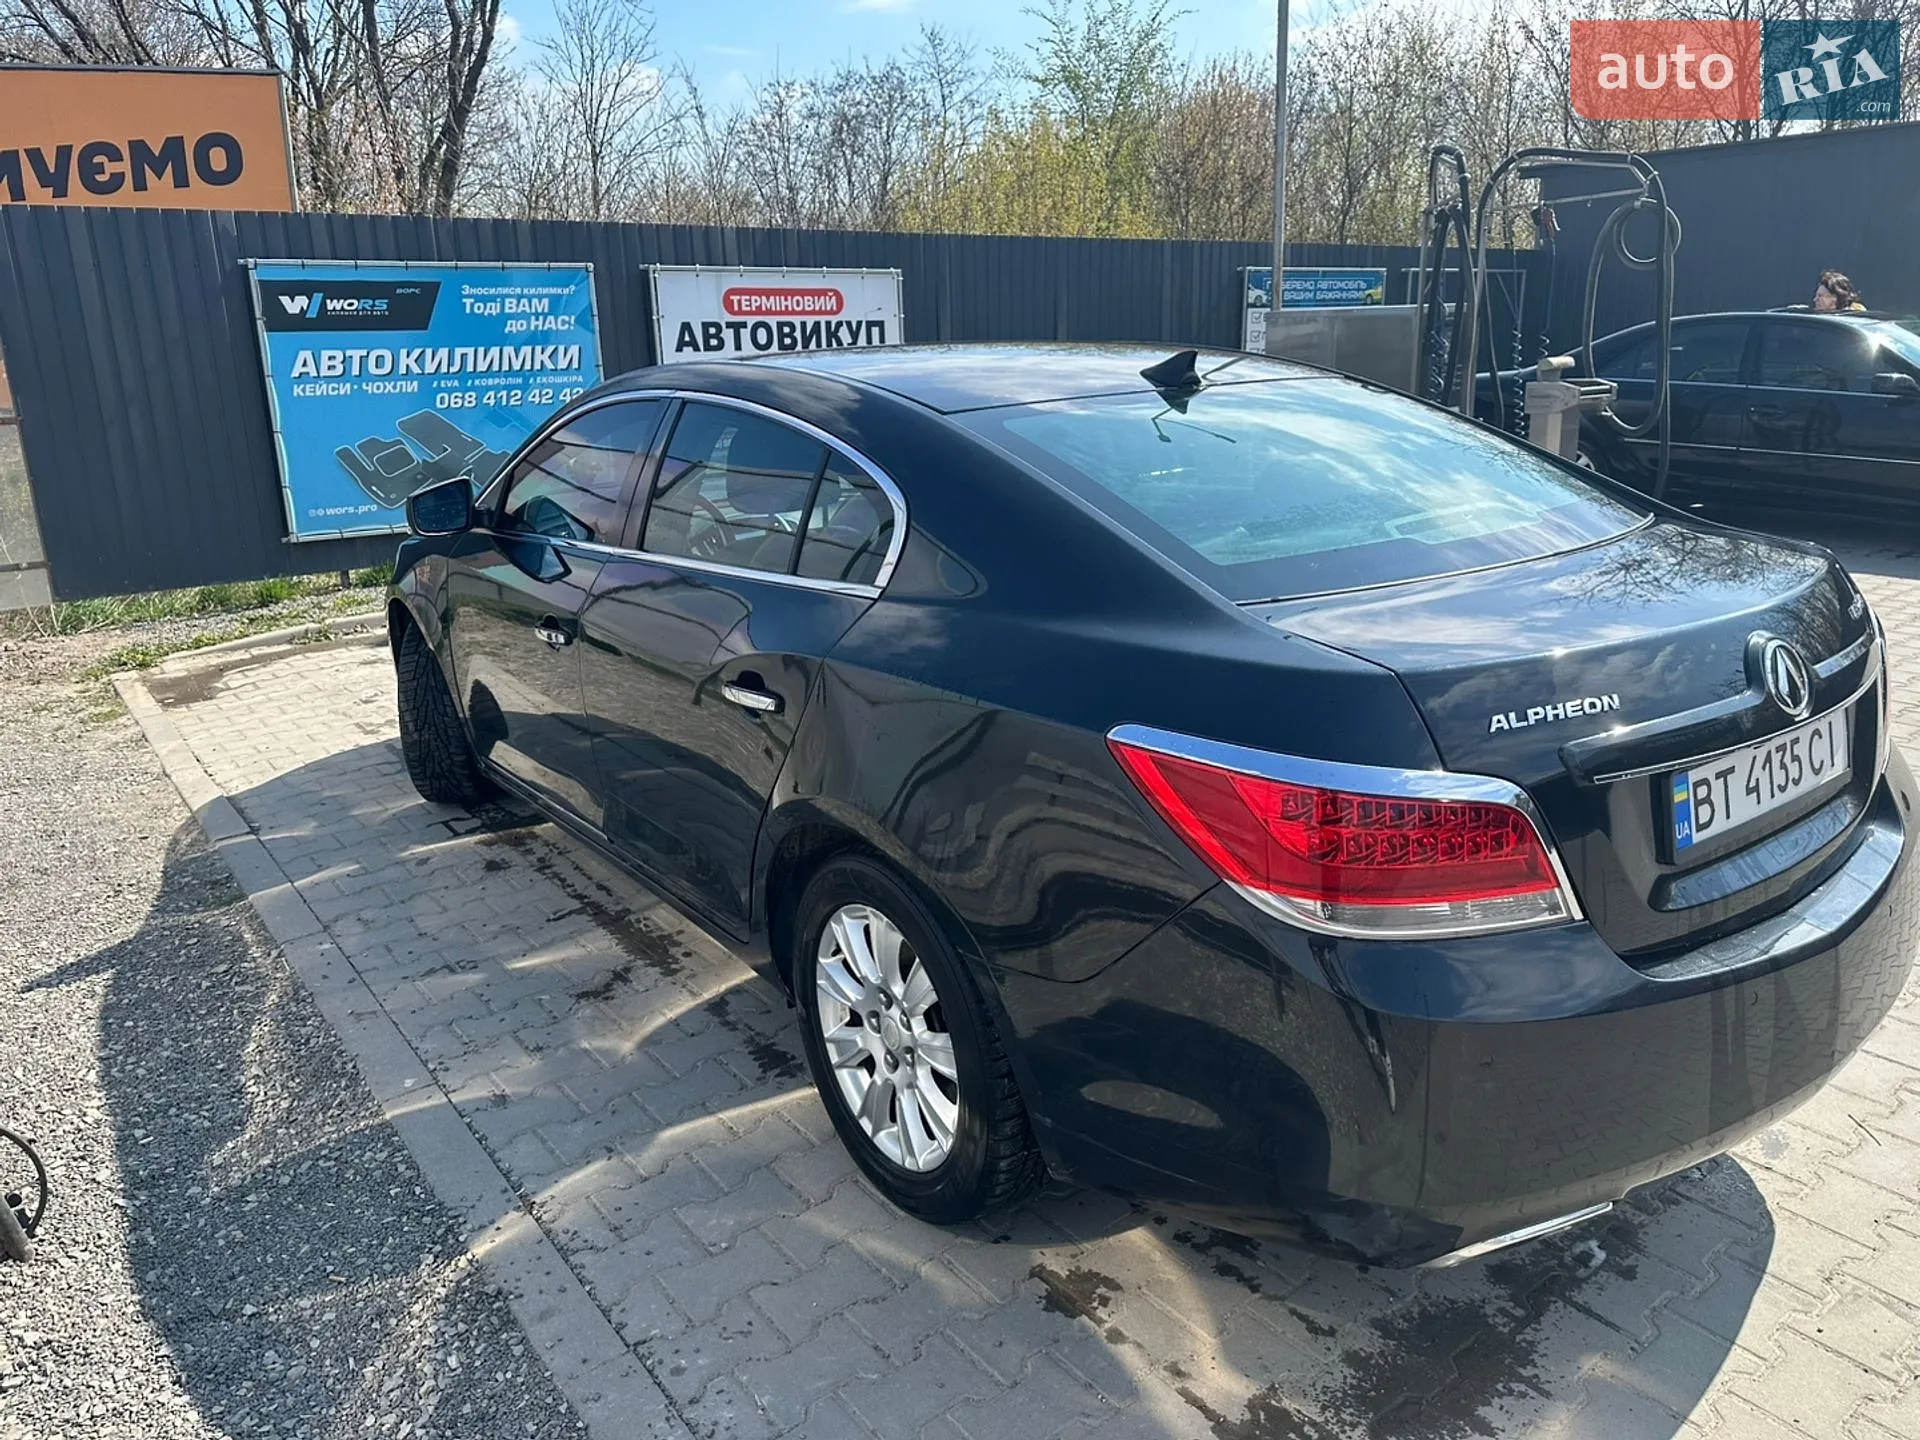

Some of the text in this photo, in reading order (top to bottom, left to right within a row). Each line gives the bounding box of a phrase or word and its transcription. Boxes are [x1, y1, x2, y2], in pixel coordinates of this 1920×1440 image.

[461, 284, 577, 296] Зносилися килимки?
[325, 298, 390, 311] WORS
[461, 297, 550, 317] Тоді ВАМ
[729, 291, 838, 312] ТЕРМІНОВИЙ
[504, 314, 576, 334] до НАС!
[674, 319, 886, 353] АВТОВИКУП
[292, 380, 419, 397] КЕЙСИ ЧОХЛИ
[473, 374, 584, 387] КОВРОЛІН ЕКОШКІРА
[435, 391, 477, 410] 068
[482, 389, 523, 407] 412
[527, 388, 554, 405] 42
[325, 503, 379, 516] wors.pro
[1488, 693, 1622, 734] ALPHEON
[1692, 720, 1835, 834] BT 4135 CI
[1675, 821, 1691, 839] UA
